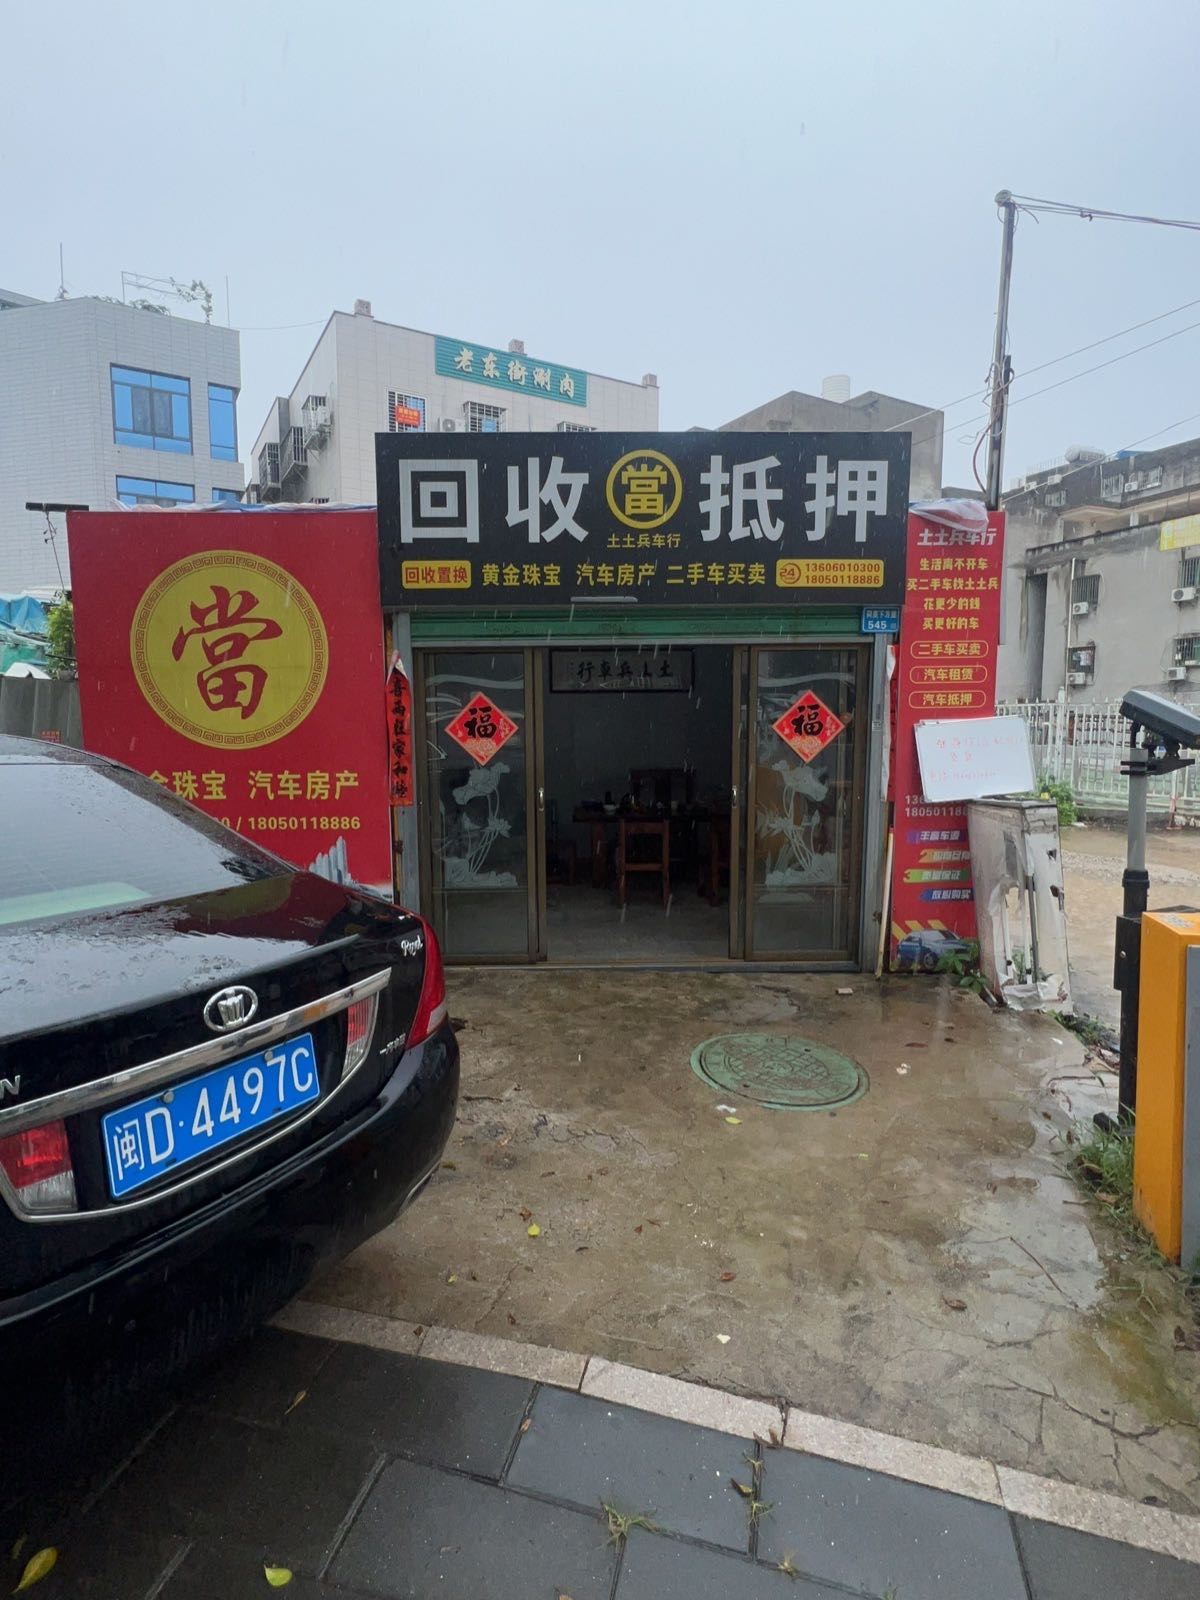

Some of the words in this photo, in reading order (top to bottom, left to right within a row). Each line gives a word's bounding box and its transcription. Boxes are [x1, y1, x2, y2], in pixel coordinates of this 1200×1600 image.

[398, 455, 590, 544] 回收
[621, 463, 668, 516] 當
[699, 455, 889, 543] 抵押
[606, 533, 681, 548] 土土兵车行
[404, 566, 468, 584] 回收置换
[481, 563, 561, 587] 黄金珠宝
[576, 563, 657, 586] 汽车房产
[666, 562, 766, 586] 二手车买卖
[805, 562, 881, 573] 13606010300
[804, 575, 881, 585] 18050118886
[867, 620, 887, 630] 545
[922, 616, 980, 630] 买更好的车
[171, 584, 284, 720] 當
[918, 643, 981, 656] 二手车买卖
[923, 667, 974, 681] 汽车租赁
[922, 693, 973, 707] 汽车抵押
[464, 705, 497, 739] 福
[791, 703, 824, 737] 福
[247, 769, 360, 801] 汽车房产
[248, 816, 362, 831] 18050118886
